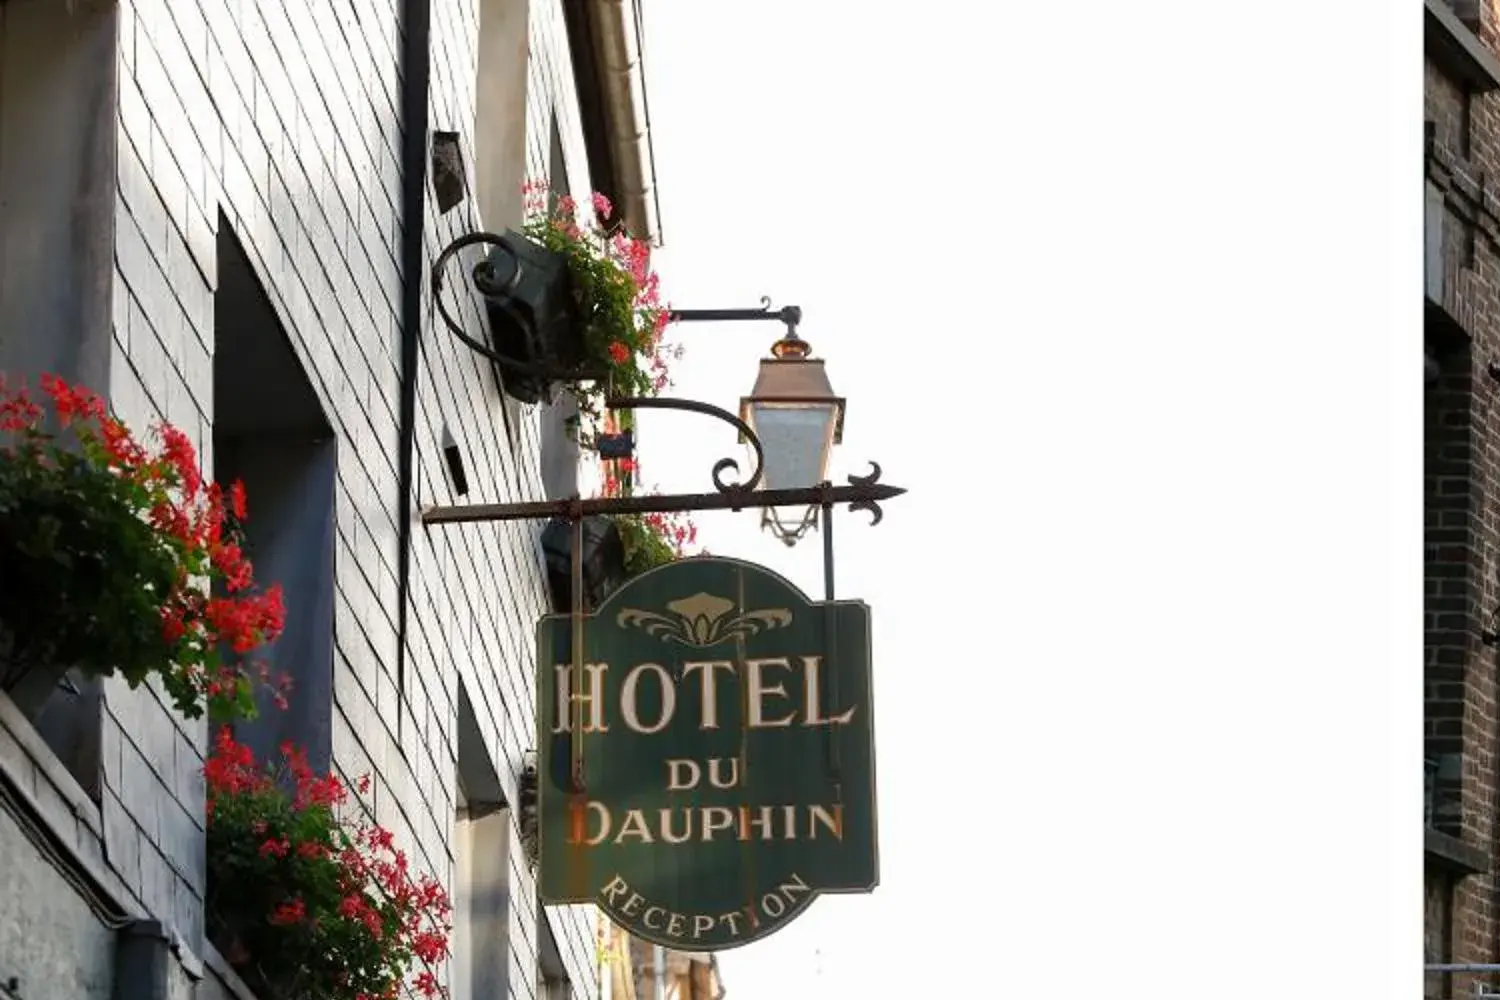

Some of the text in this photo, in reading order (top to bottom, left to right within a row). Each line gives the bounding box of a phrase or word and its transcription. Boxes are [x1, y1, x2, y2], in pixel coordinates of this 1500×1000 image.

[551, 655, 858, 735] HOTEL
[666, 756, 740, 790] DU
[566, 801, 846, 847] DAUPHIN
[600, 871, 812, 939] RECEPTION
